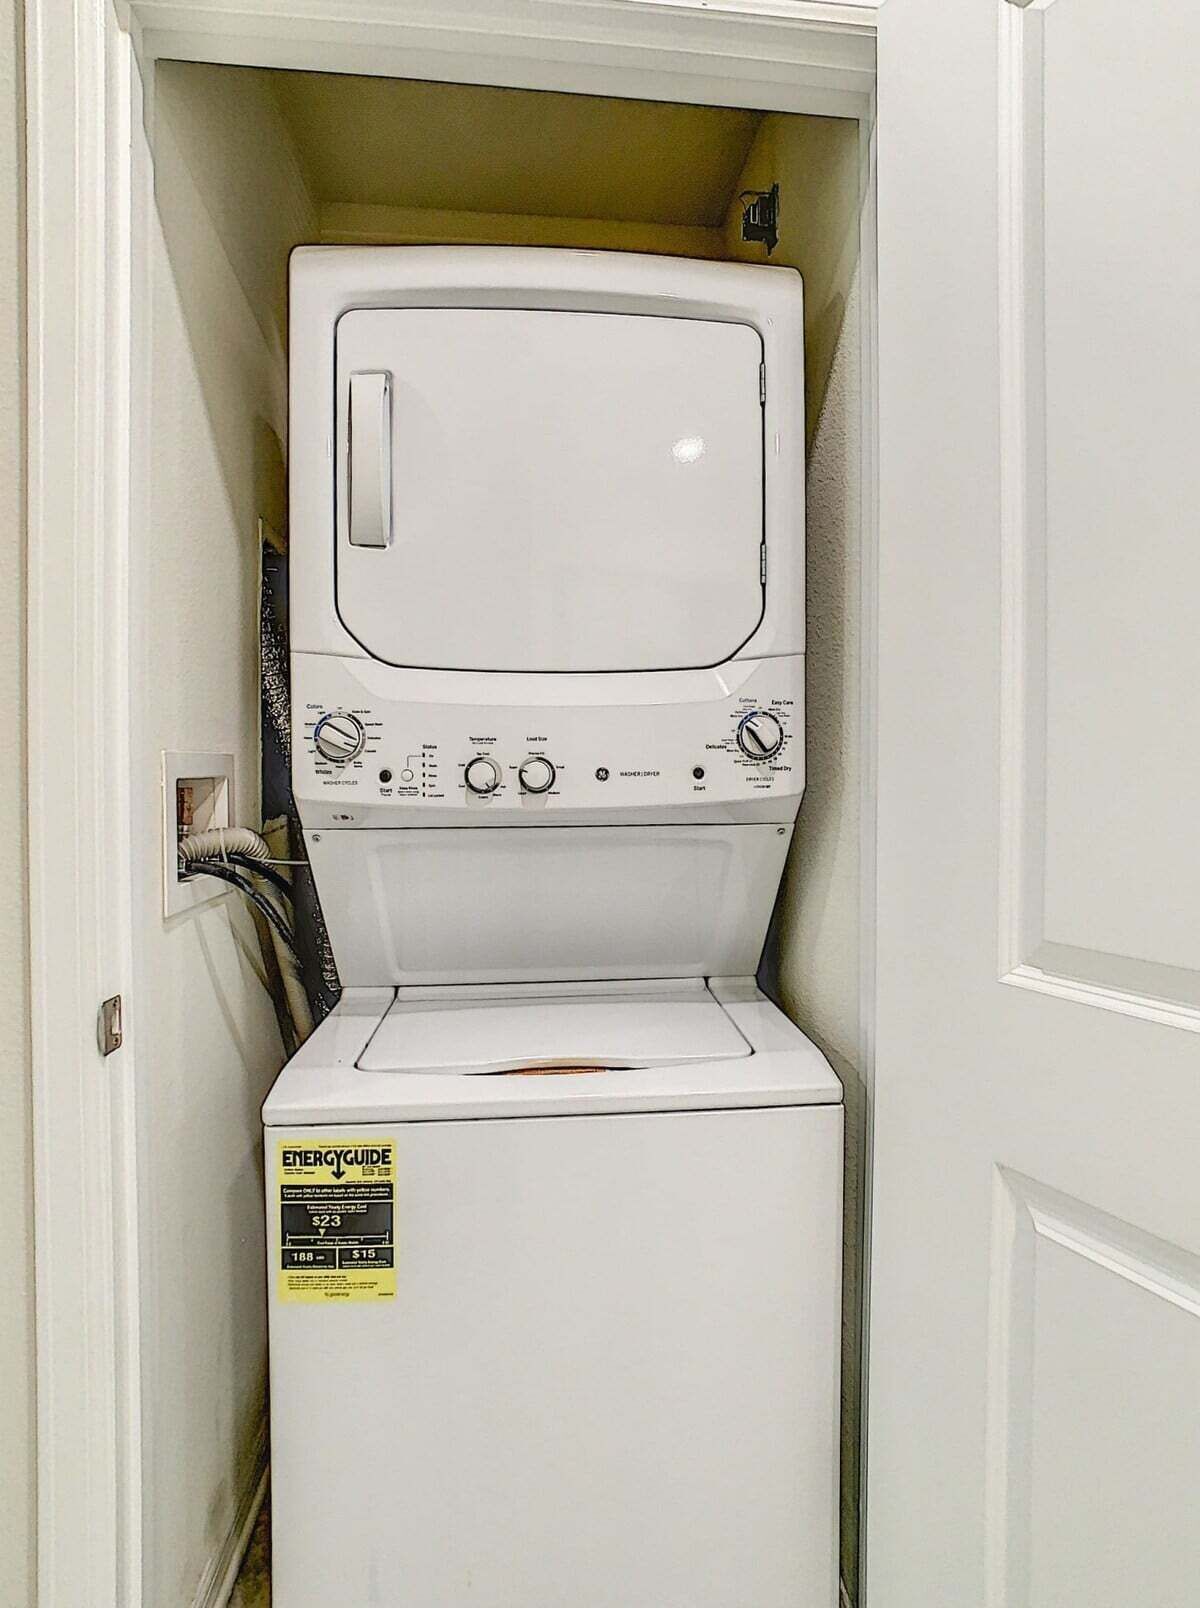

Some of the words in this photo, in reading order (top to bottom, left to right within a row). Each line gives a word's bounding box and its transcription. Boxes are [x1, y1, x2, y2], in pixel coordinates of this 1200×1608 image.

[282, 1149, 392, 1168] ENERGYGUIDE
[312, 1214, 342, 1228] $23
[291, 1252, 314, 1262] 188
[352, 1248, 376, 1259] $15
